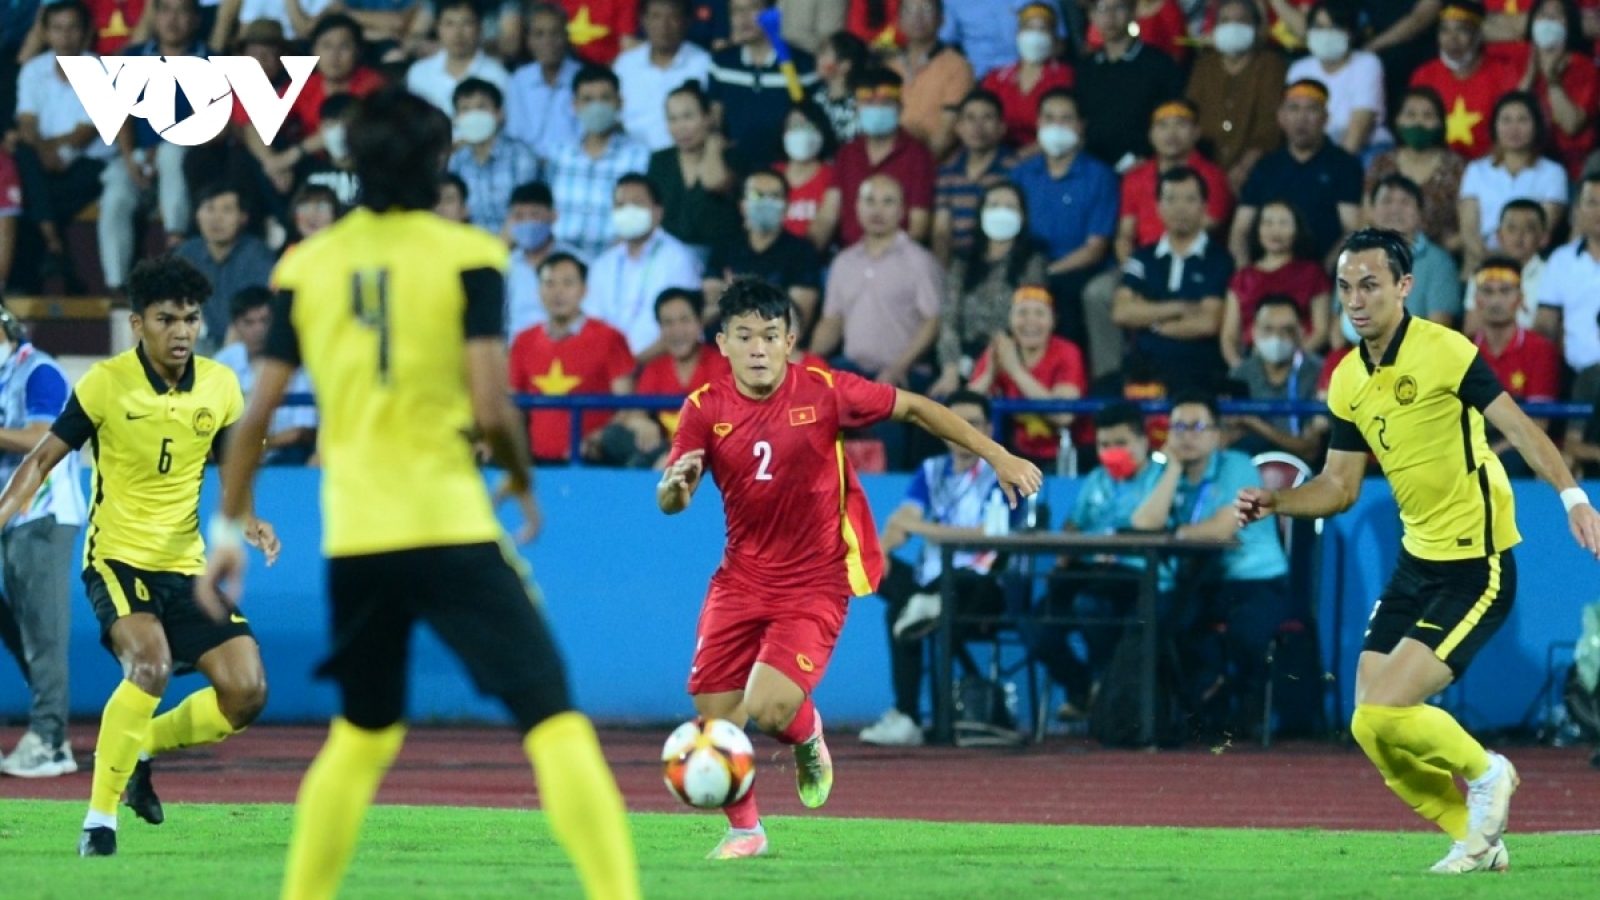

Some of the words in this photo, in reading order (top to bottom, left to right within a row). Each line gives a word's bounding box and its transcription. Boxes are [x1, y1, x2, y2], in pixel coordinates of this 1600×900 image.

[352, 267, 389, 382] 4
[158, 437, 173, 474] 6
[752, 441, 773, 480] 2
[134, 577, 150, 601] 6
